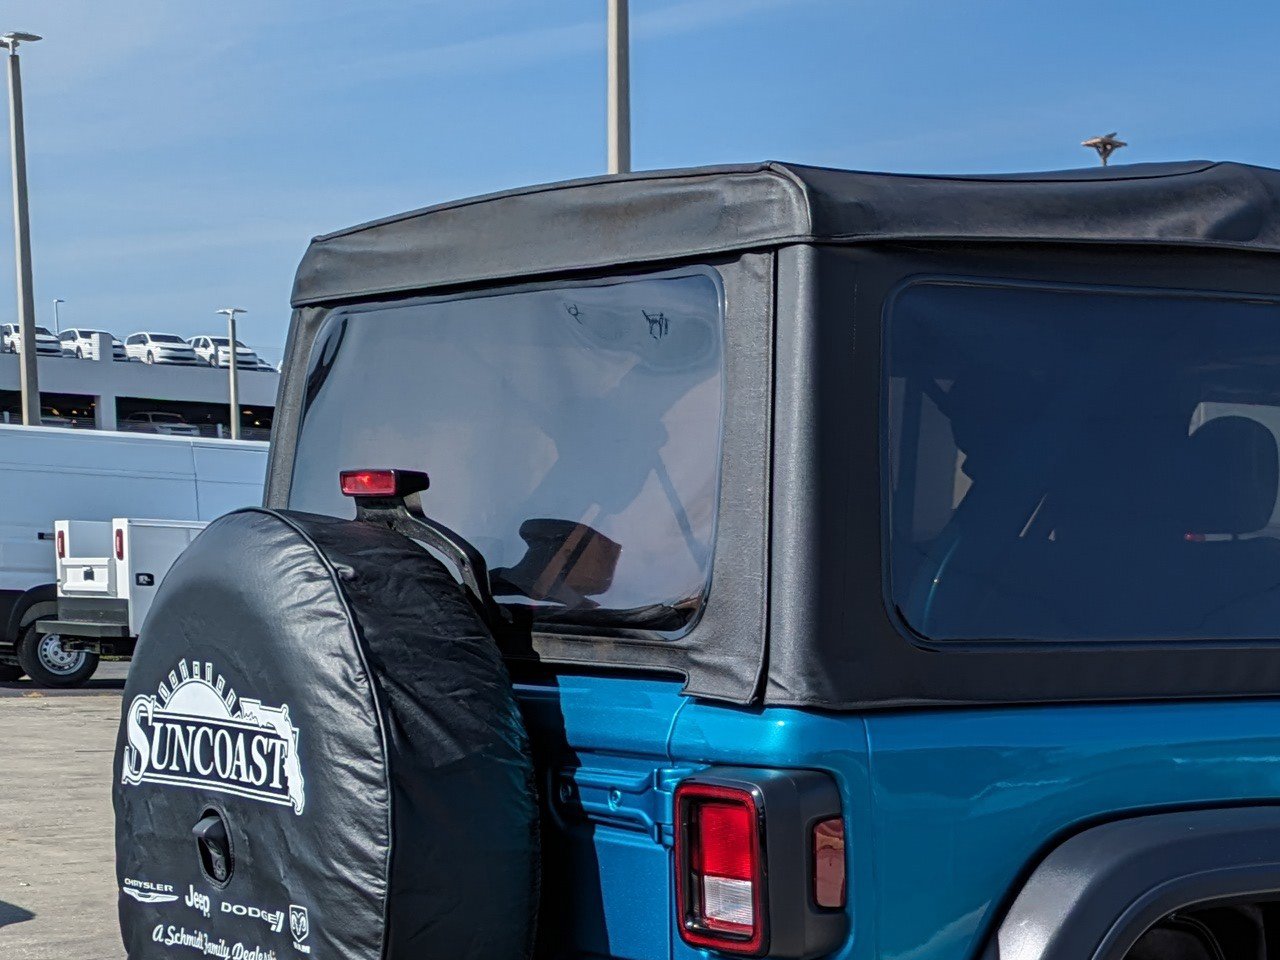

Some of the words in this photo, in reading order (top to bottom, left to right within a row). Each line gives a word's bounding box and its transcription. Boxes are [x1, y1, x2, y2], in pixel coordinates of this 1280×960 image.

[122, 694, 289, 789] SUNCOAST
[124, 877, 174, 892] CHRYSLER
[185, 884, 211, 918] Jeep
[221, 901, 279, 925] DODGE
[152, 924, 163, 942] A
[165, 925, 204, 951] Schmidt
